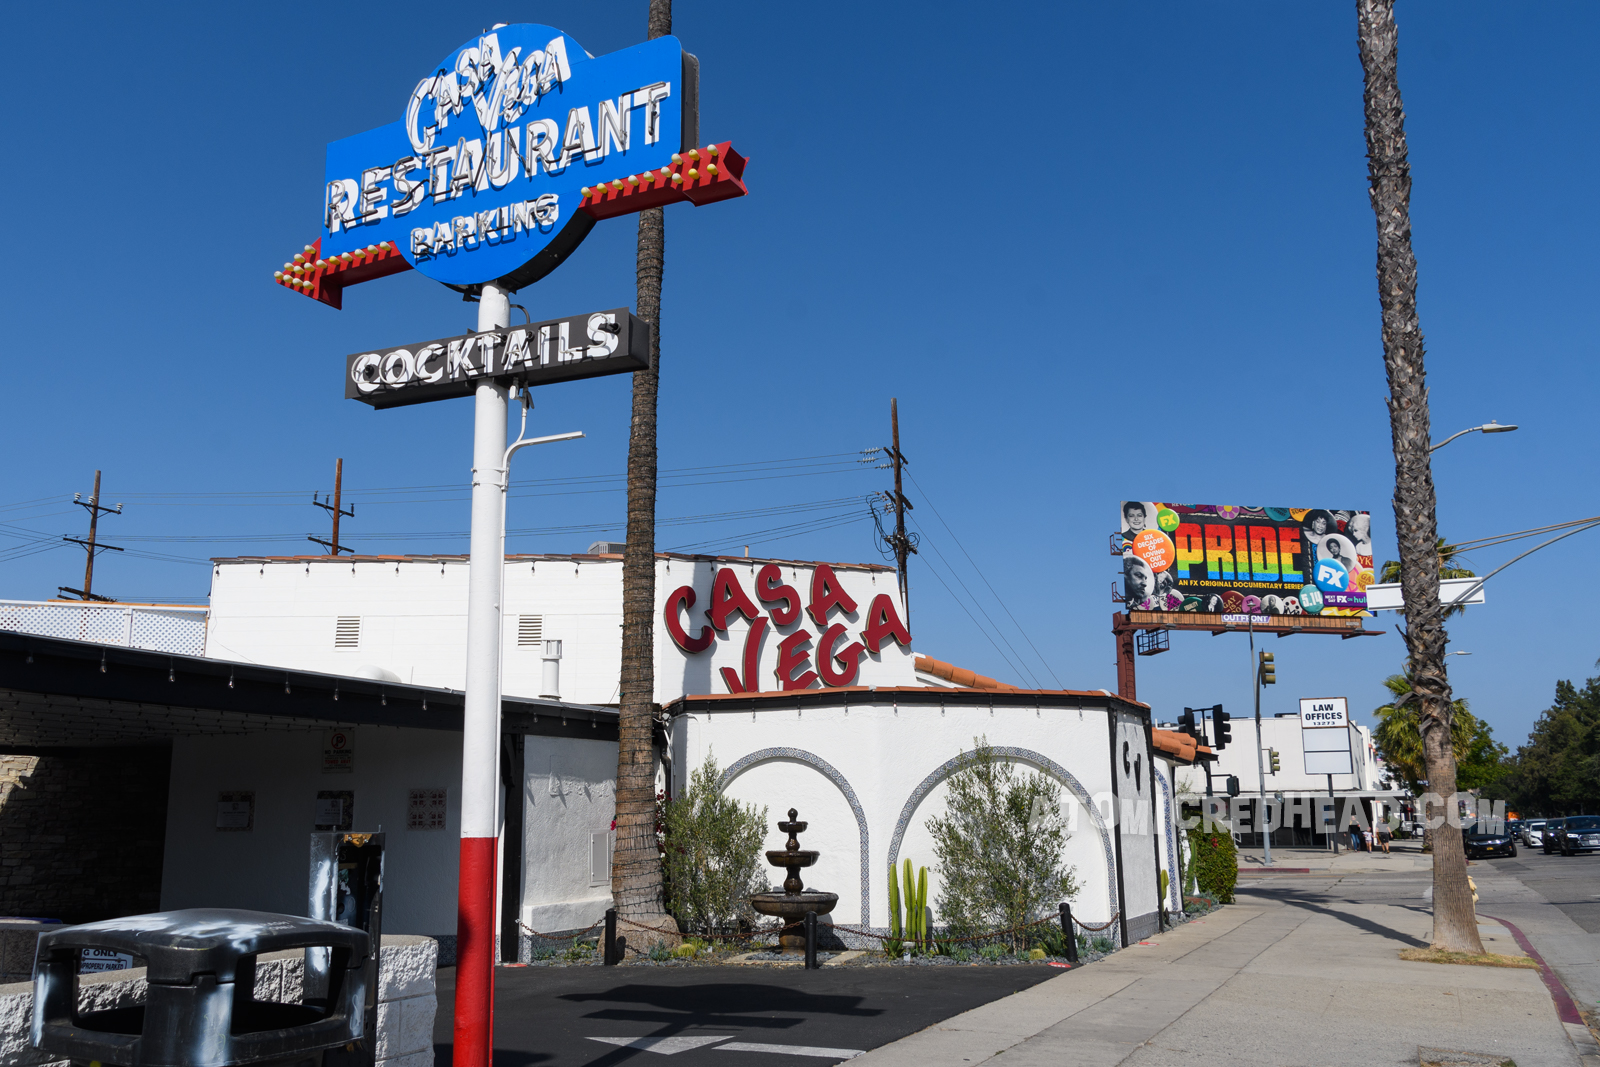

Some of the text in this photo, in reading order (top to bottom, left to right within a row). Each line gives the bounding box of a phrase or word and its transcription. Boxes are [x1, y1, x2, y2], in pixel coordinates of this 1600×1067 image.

[406, 33, 503, 153] CASA
[471, 36, 572, 131] VEGA
[324, 82, 671, 234] RESTAURANT
[410, 193, 560, 258] PARKING
[351, 313, 621, 391] COCKTAILS
[1159, 514, 1176, 527] FX
[1137, 538, 1164, 548] DECADES
[1175, 523, 1304, 582] PRIDE
[1143, 549, 1165, 558] LOVING
[1151, 560, 1166, 569] LOUD
[1199, 580, 1232, 588] ORIGINAL
[1233, 581, 1282, 589] DOCUMENTARY
[1317, 564, 1345, 589] FX
[665, 564, 858, 654] CASA
[1300, 592, 1323, 607] 5.14
[1336, 595, 1348, 603] FX
[1354, 596, 1367, 604] hul
[719, 593, 913, 694] VEGA
[1305, 712, 1343, 720] OFFICES
[93, 949, 117, 957] ONLY
